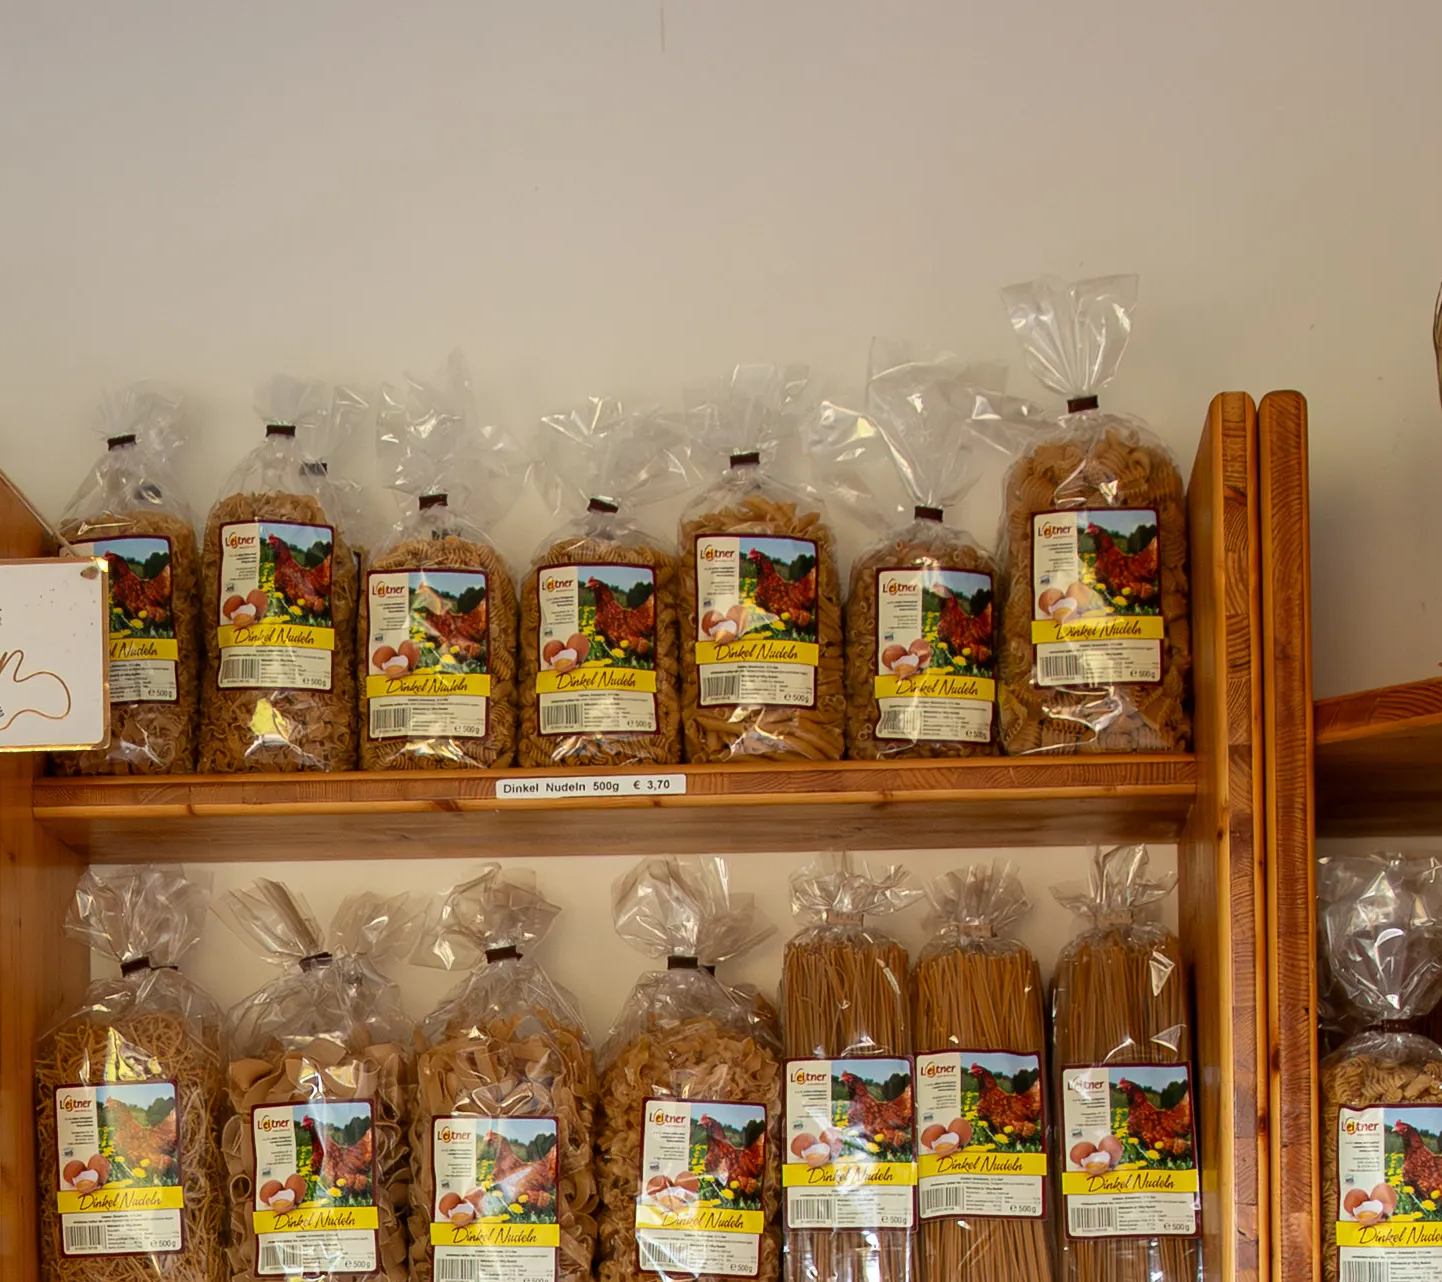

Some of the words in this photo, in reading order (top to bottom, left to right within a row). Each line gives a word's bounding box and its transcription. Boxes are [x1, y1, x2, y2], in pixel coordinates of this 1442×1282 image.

[699, 543, 736, 562] Leitner
[715, 642, 755, 661] Dinkel
[755, 643, 799, 661] Nudeln
[502, 782, 540, 794] Dinkel
[545, 781, 587, 793] Nudeln
[592, 780, 620, 793] 500g
[646, 778, 671, 791] 3,70
[920, 1060, 956, 1078] Leitner
[936, 1154, 978, 1173] Dinkel
[978, 1153, 1024, 1172] Nudeln
